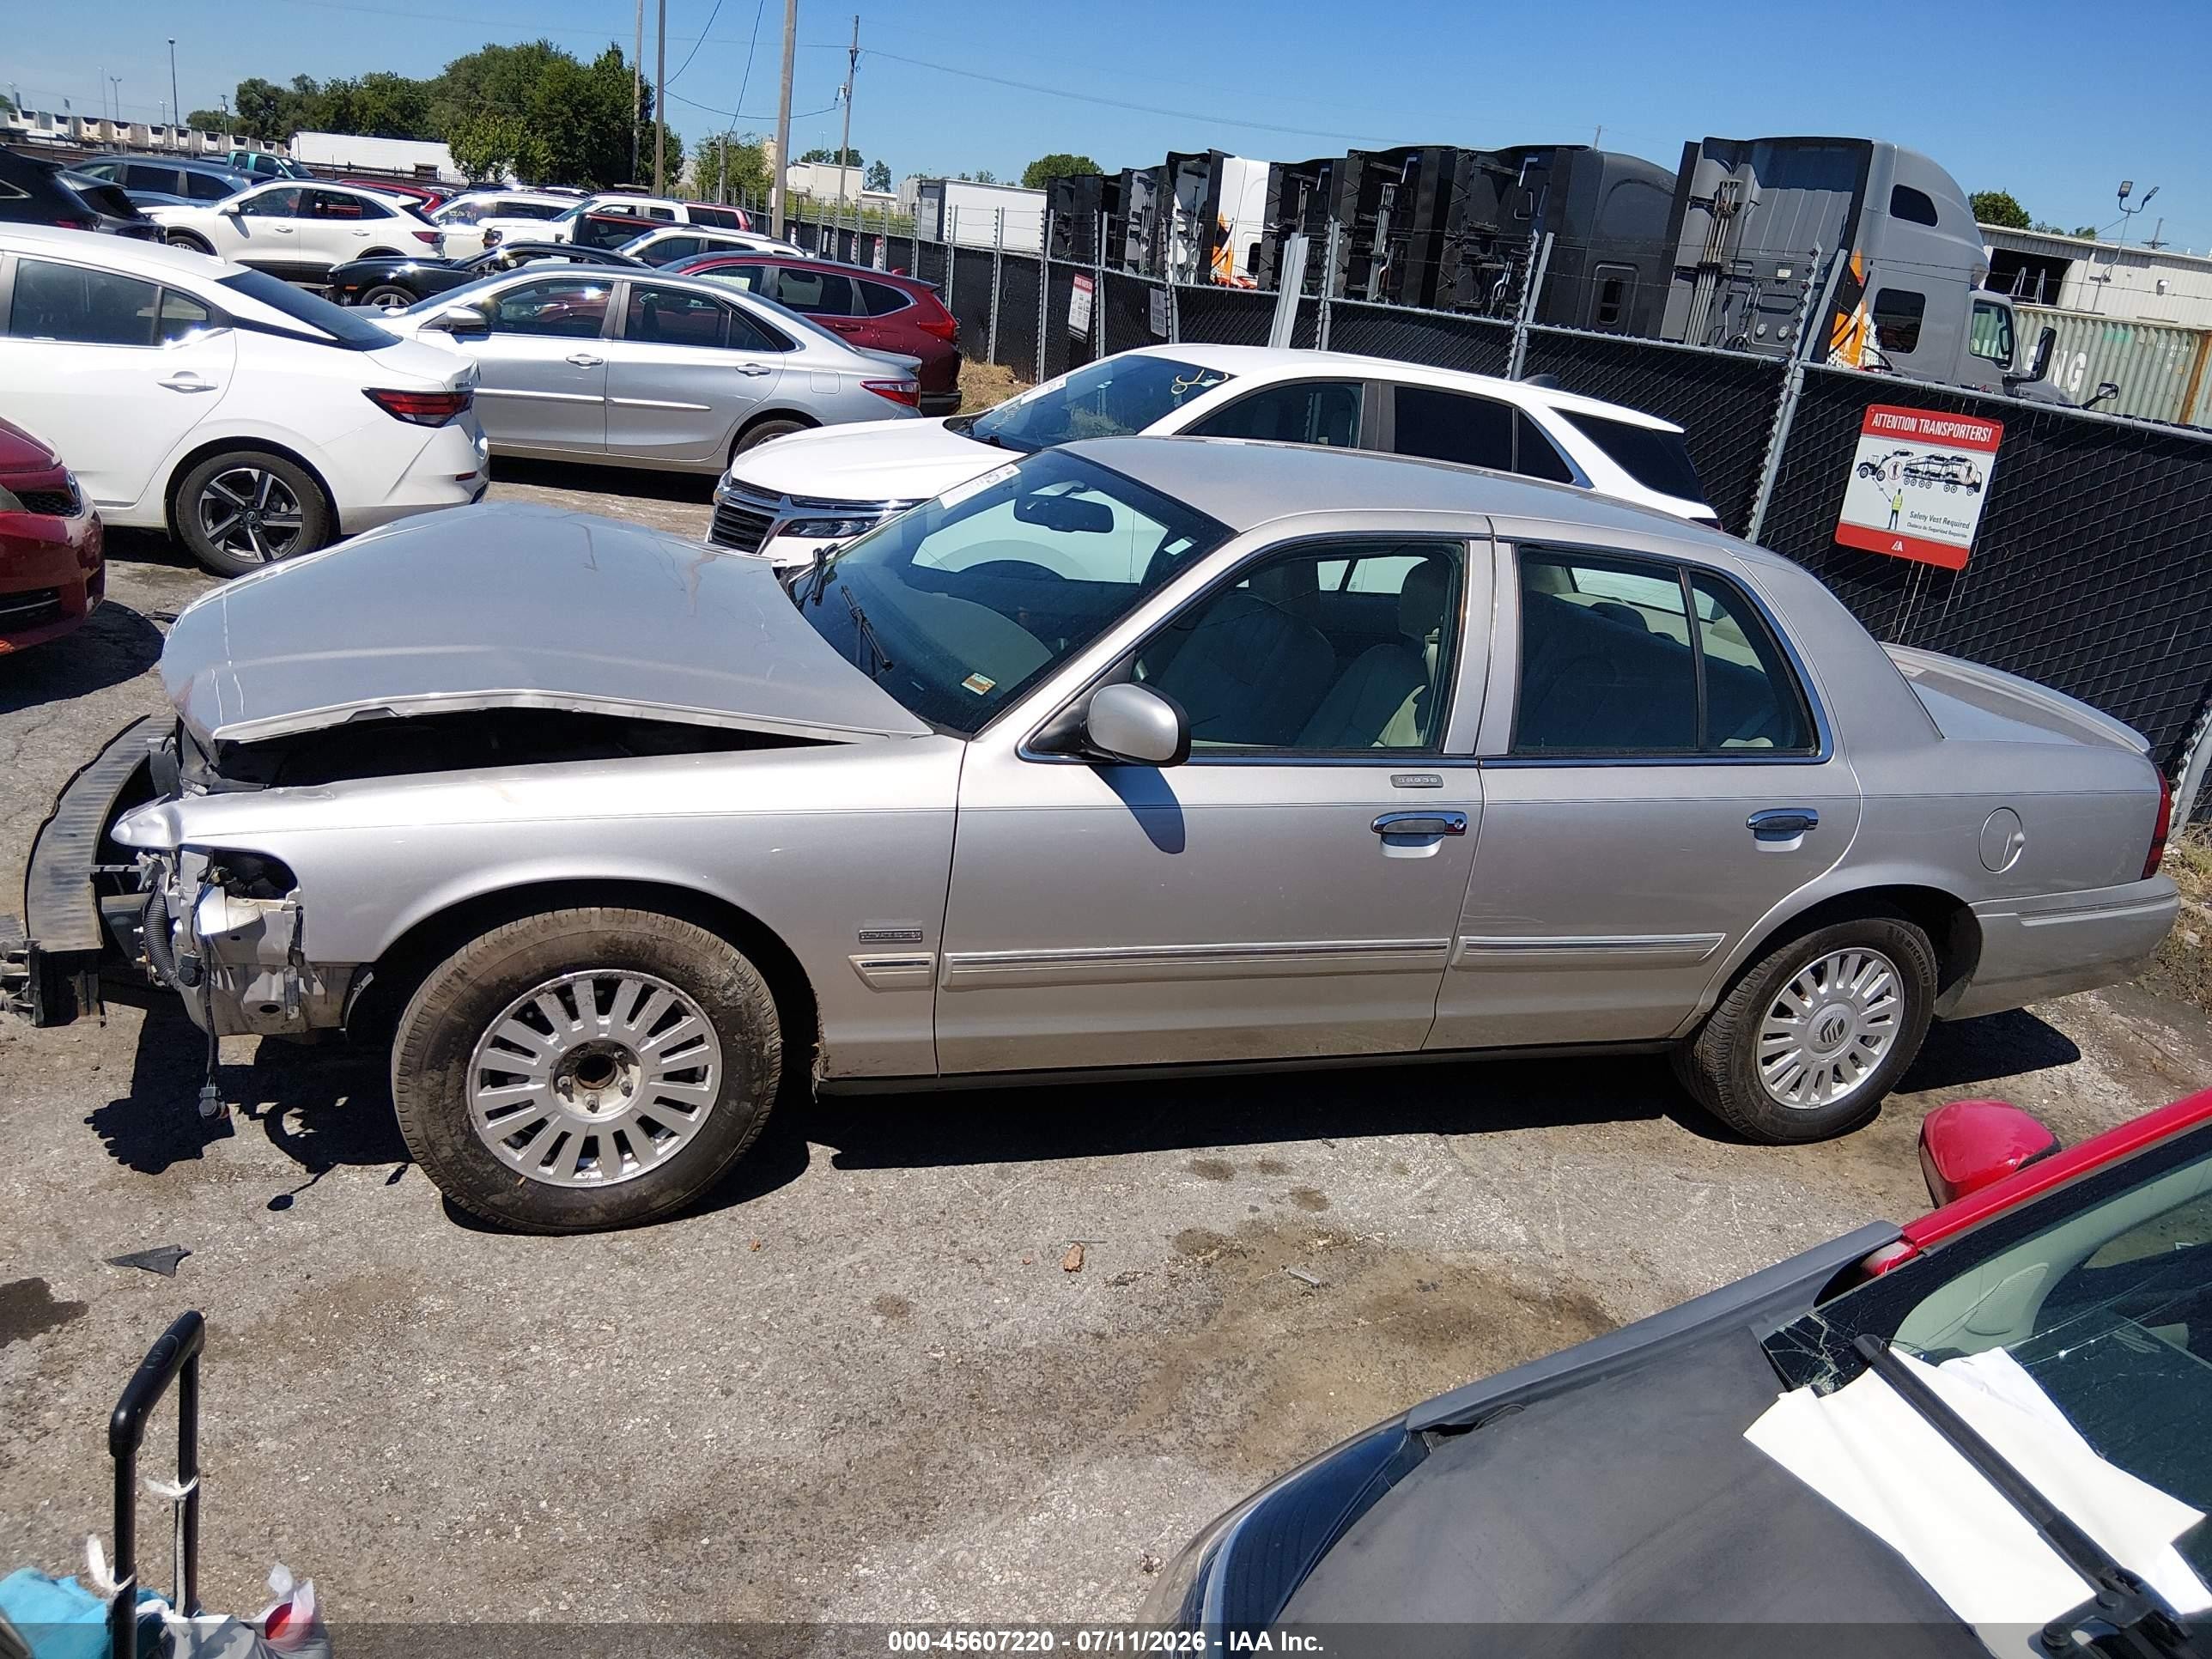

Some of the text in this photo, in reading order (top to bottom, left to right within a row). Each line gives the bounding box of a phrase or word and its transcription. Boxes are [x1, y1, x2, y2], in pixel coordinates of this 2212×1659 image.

[1871, 413, 1993, 442] ATTENTION TRANSPORTERS!
[1909, 511, 1971, 529] Safety Vest Required
[1903, 939, 1929, 986] MICHELIN
